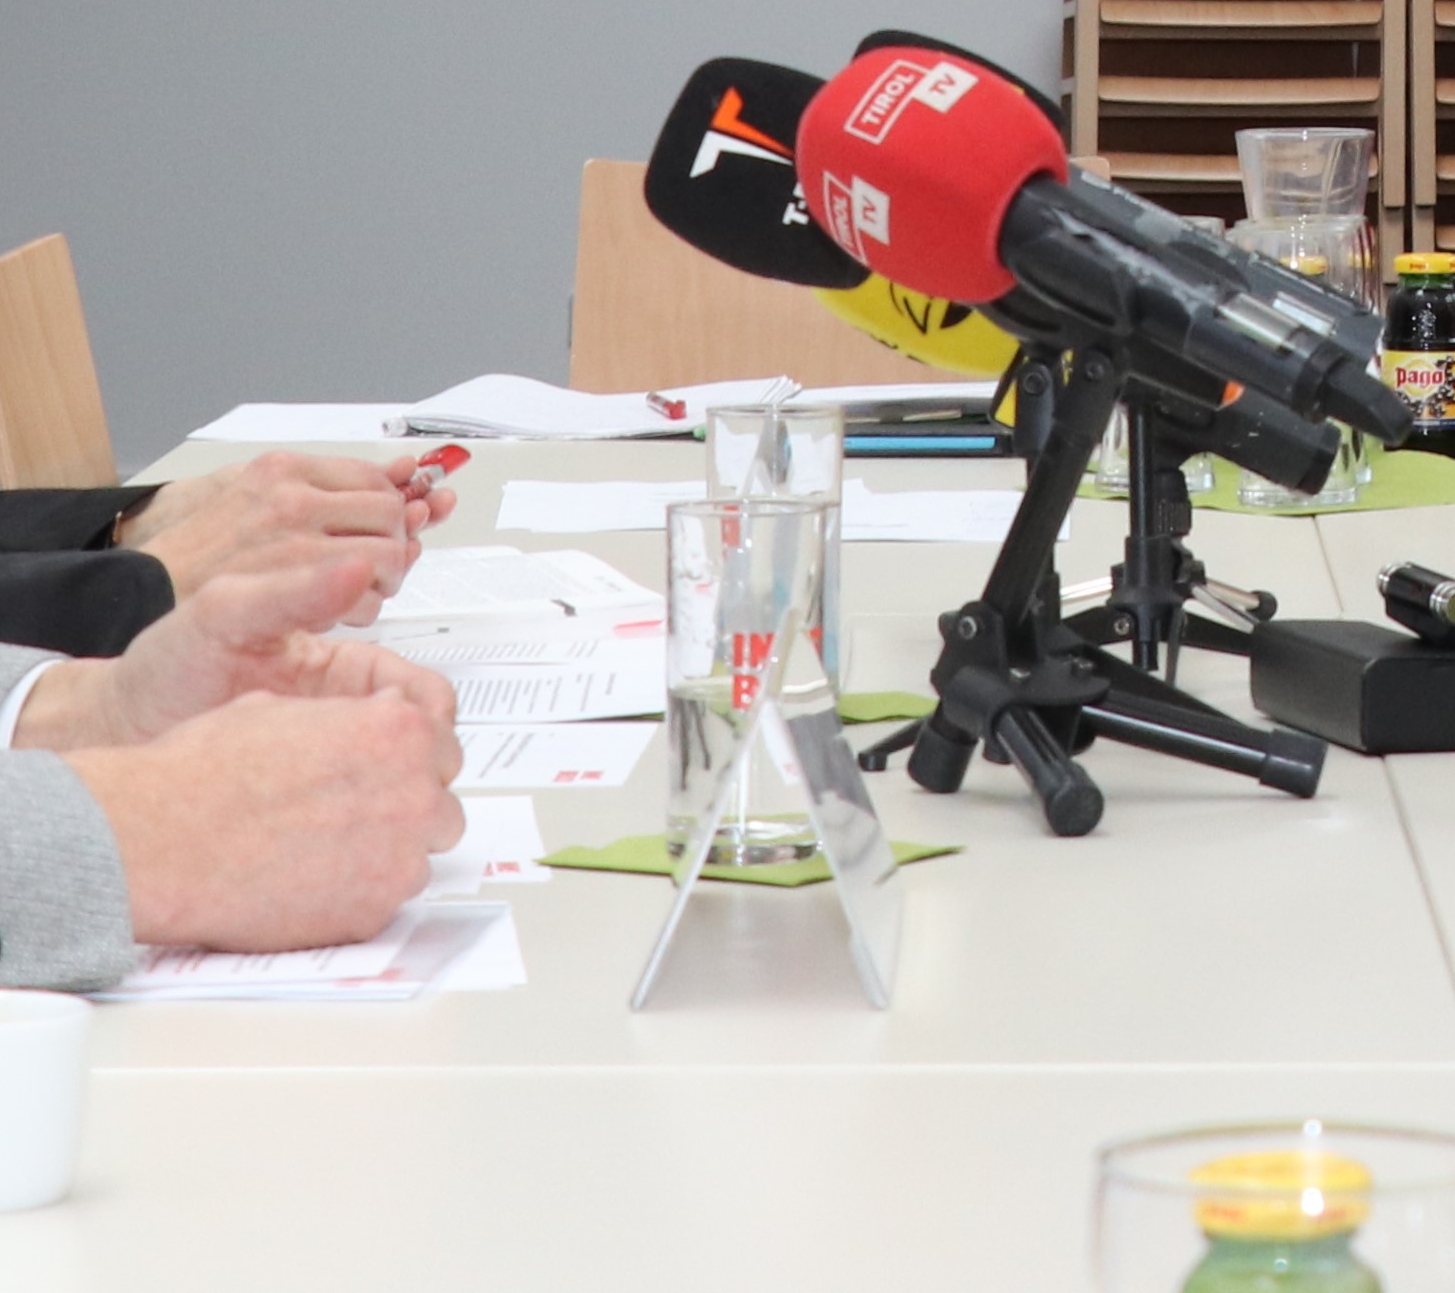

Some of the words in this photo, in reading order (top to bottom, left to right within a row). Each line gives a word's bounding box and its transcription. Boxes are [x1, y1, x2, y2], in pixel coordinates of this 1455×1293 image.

[860, 70, 915, 127] TIROL
[930, 71, 958, 97] TV
[1396, 366, 1445, 389] pago
